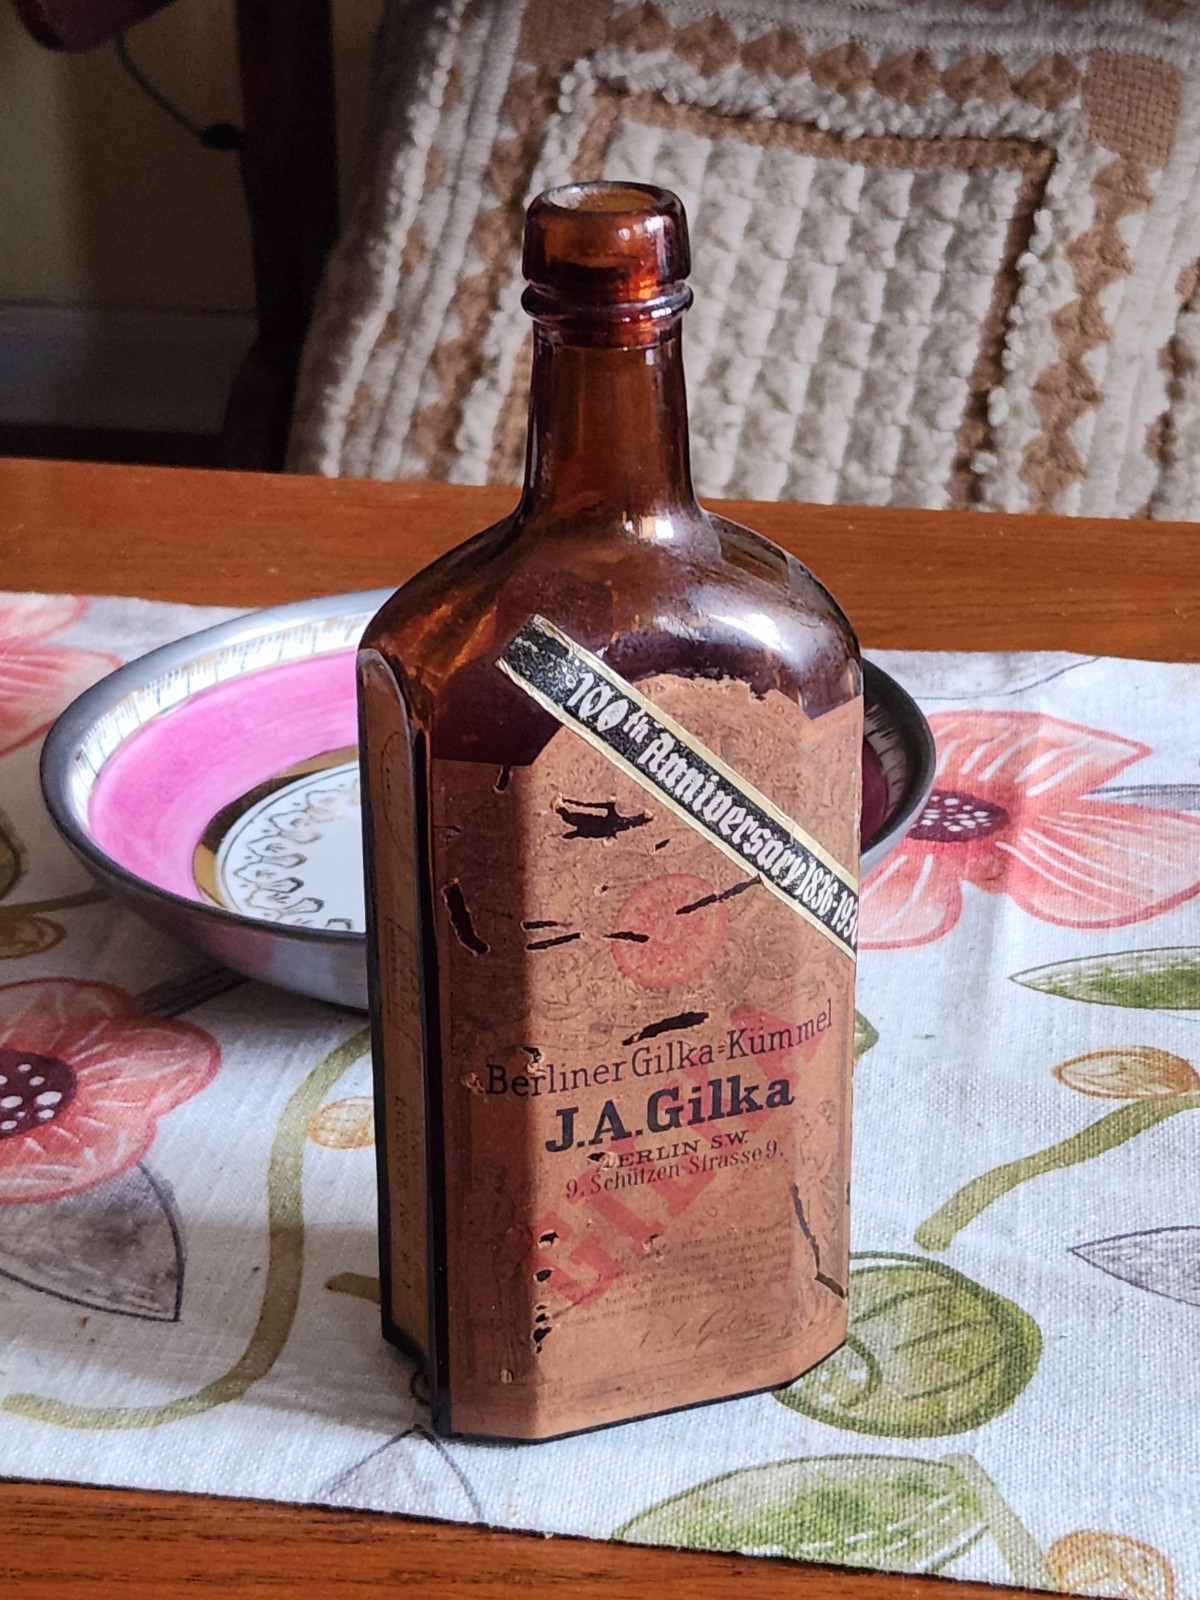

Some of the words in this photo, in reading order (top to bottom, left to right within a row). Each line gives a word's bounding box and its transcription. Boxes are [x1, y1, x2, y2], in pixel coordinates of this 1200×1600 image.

[566, 672, 650, 743] 100th
[637, 732, 808, 888] Anniversary
[486, 1060, 628, 1097] Berliner
